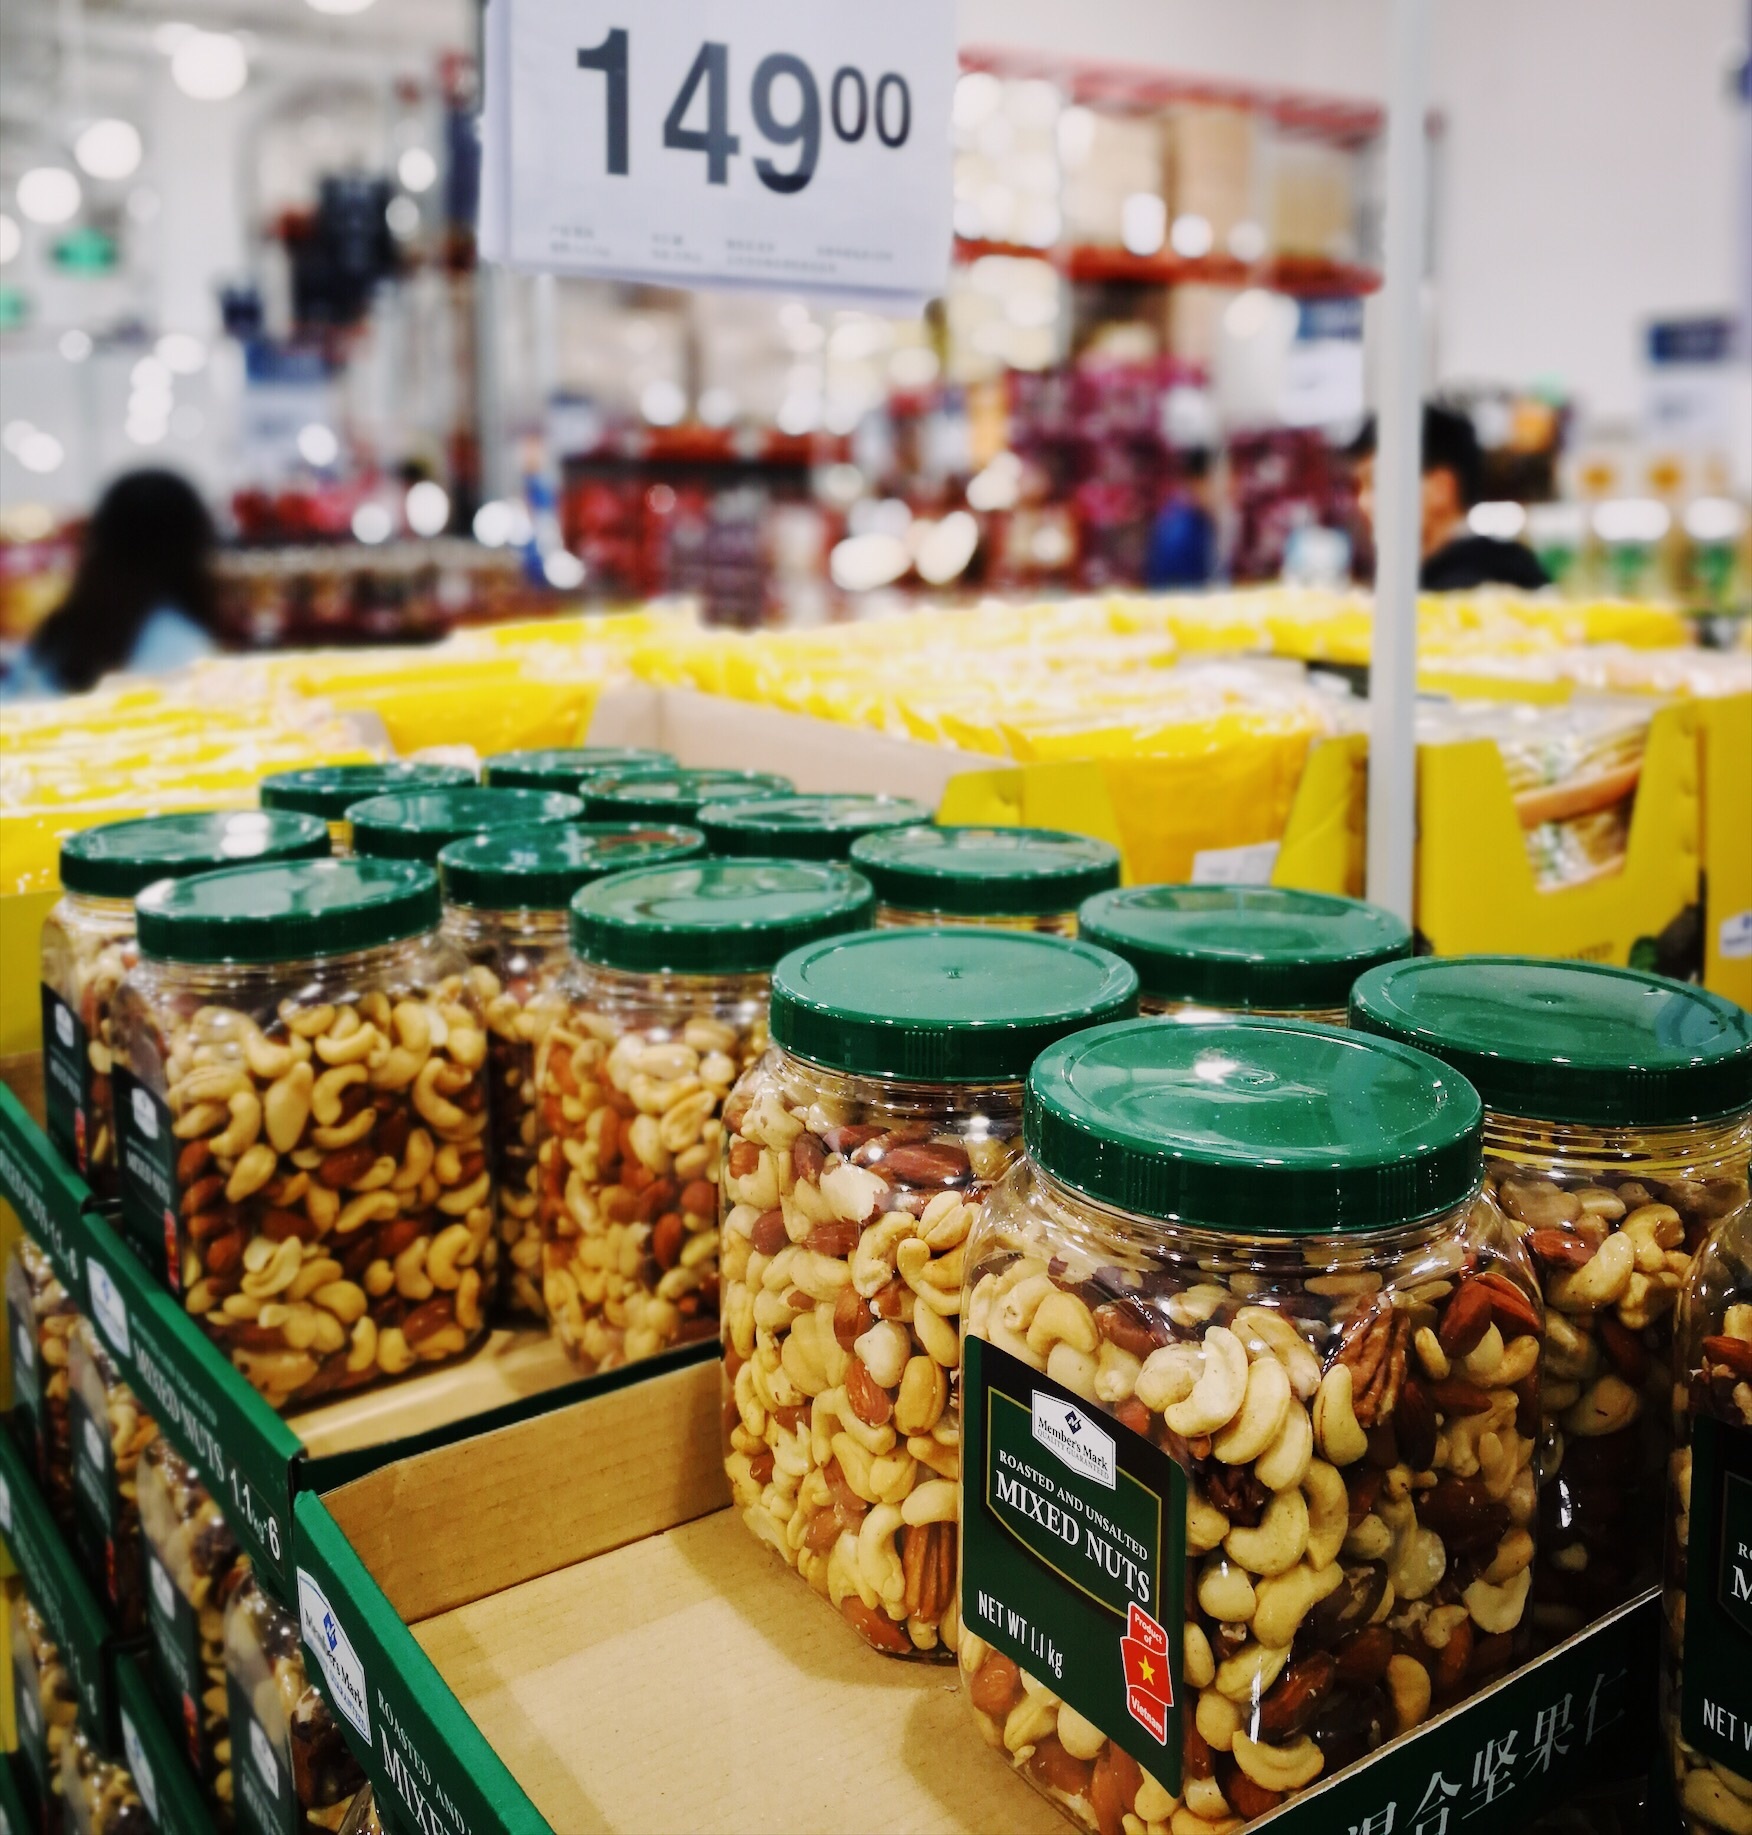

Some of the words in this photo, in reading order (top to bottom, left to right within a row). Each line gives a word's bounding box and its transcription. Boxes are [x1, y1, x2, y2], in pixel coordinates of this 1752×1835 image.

[576, 27, 822, 194] 149
[830, 66, 912, 149] 00
[1037, 1429, 1065, 1452] QUALITY
[1066, 1446, 1110, 1480] GUARANTEED
[1038, 1415, 1082, 1453] Member's
[1083, 1444, 1109, 1472] Mark
[999, 1449, 1055, 1493] ROASTED
[1056, 1487, 1084, 1512] AND
[1085, 1504, 1149, 1561] UNSALTED
[995, 1469, 1080, 1546] MIXED
[1084, 1528, 1150, 1603] NUTS
[978, 1589, 1004, 1628] NET
[1007, 1608, 1028, 1645] WT
[1030, 1626, 1044, 1659] 1.1
[1047, 1639, 1064, 1680] kg
[1134, 1612, 1163, 1645] Product
[1143, 1634, 1153, 1646] of
[1131, 1694, 1163, 1736] Vietnam
[1703, 1697, 1738, 1742] NET
[377, 1687, 432, 1786] ROASTED
[435, 1782, 465, 1835] AND
